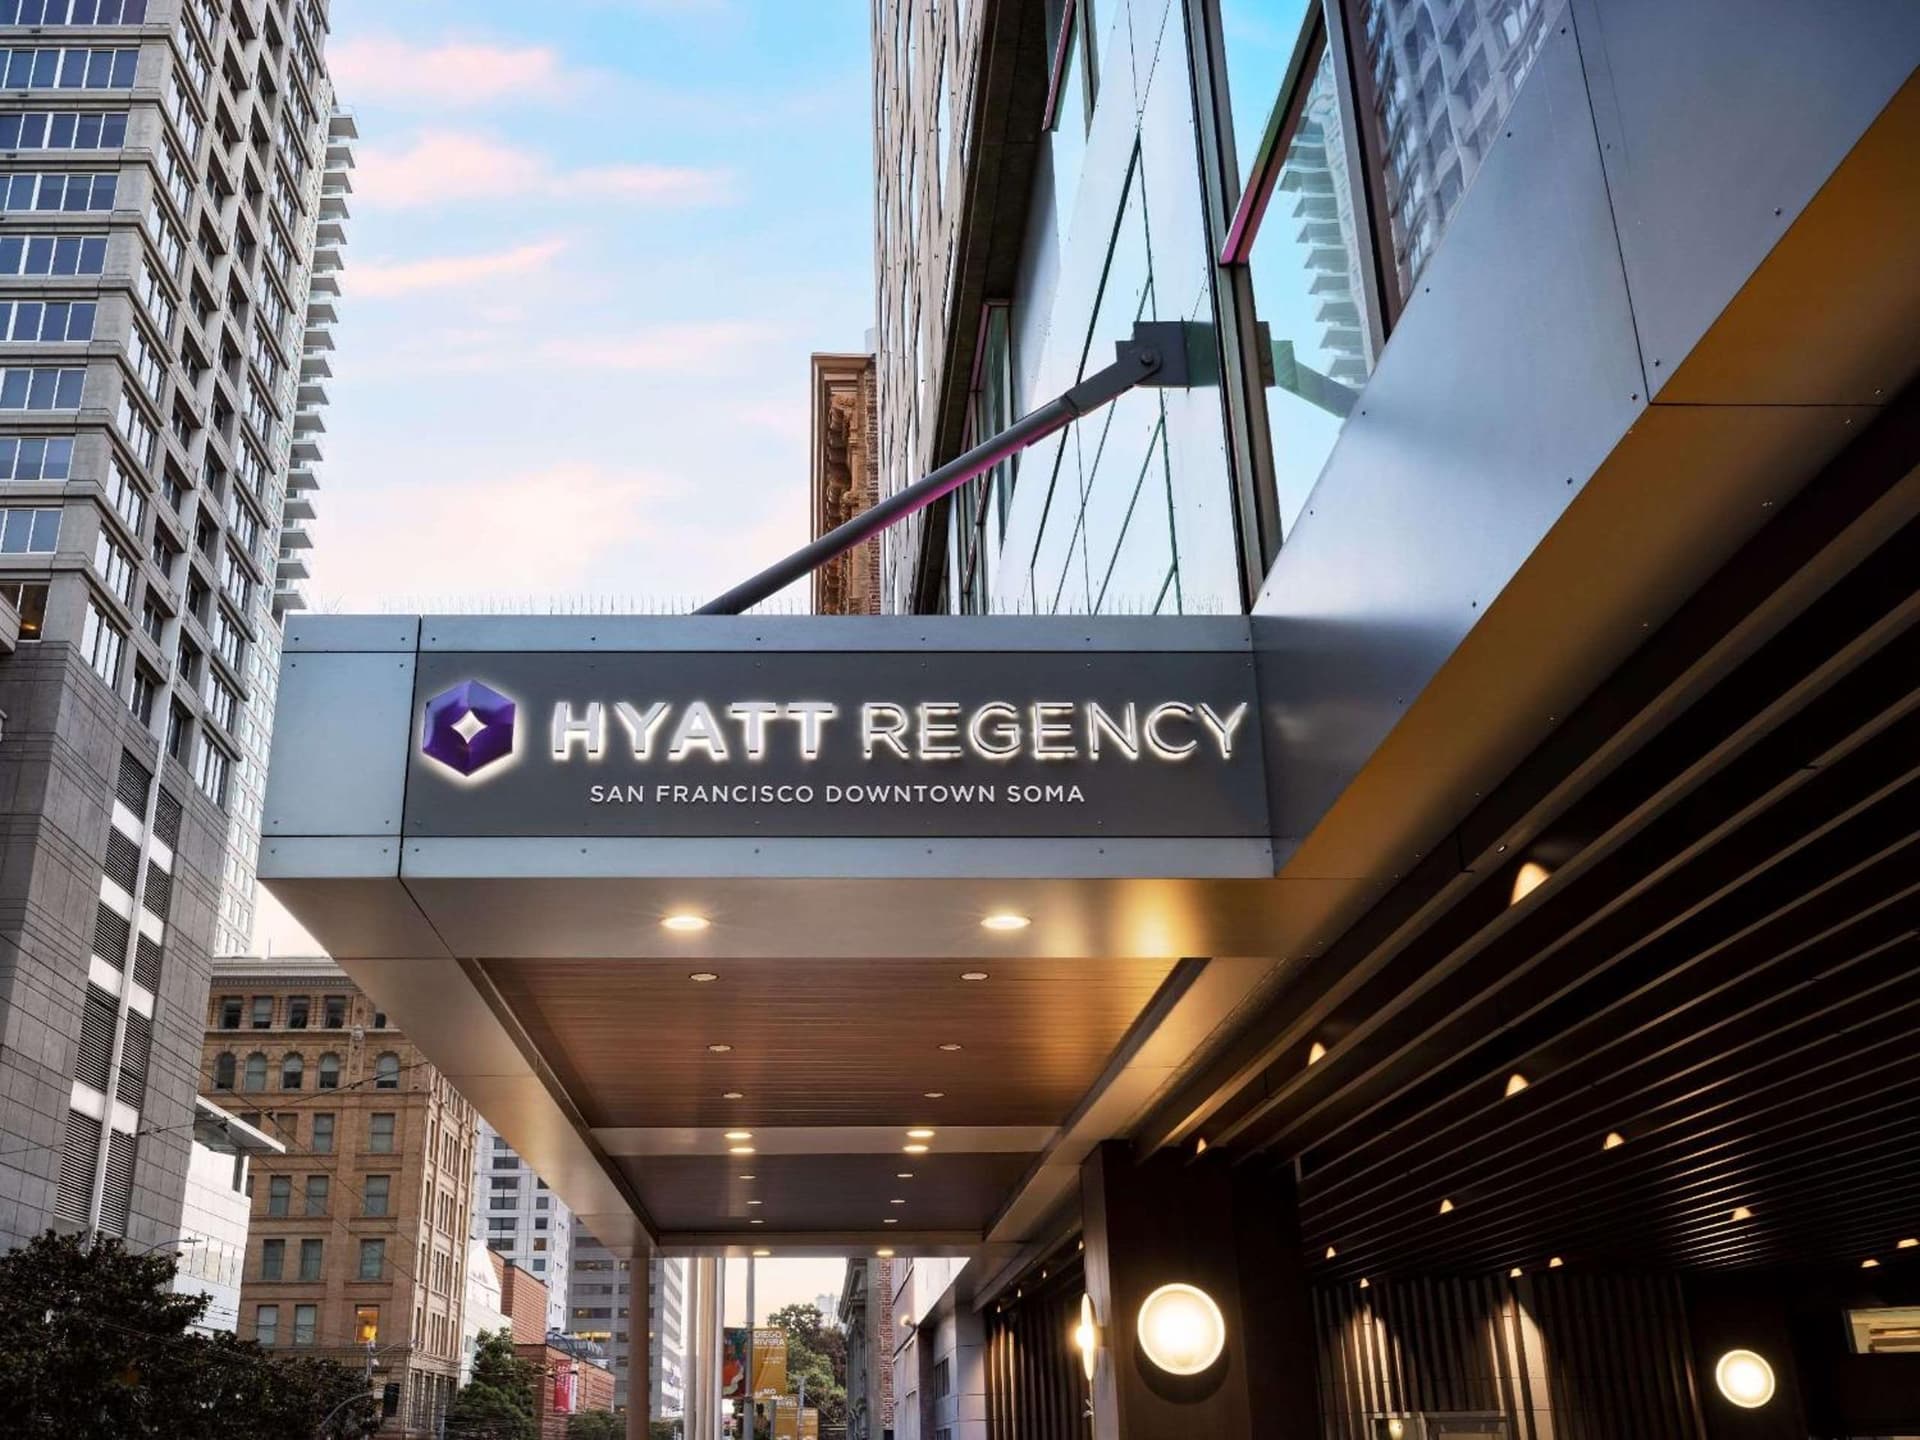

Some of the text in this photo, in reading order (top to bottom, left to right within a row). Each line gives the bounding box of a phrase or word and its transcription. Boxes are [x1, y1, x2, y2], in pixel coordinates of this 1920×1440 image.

[552, 701, 1248, 759] HYATT REGENCY
[590, 785, 1085, 803] SAN FRANCISCO DOWNTOWN SOMA
[753, 1330, 782, 1338] DIEGO
[753, 1338, 785, 1346] RIVERA
